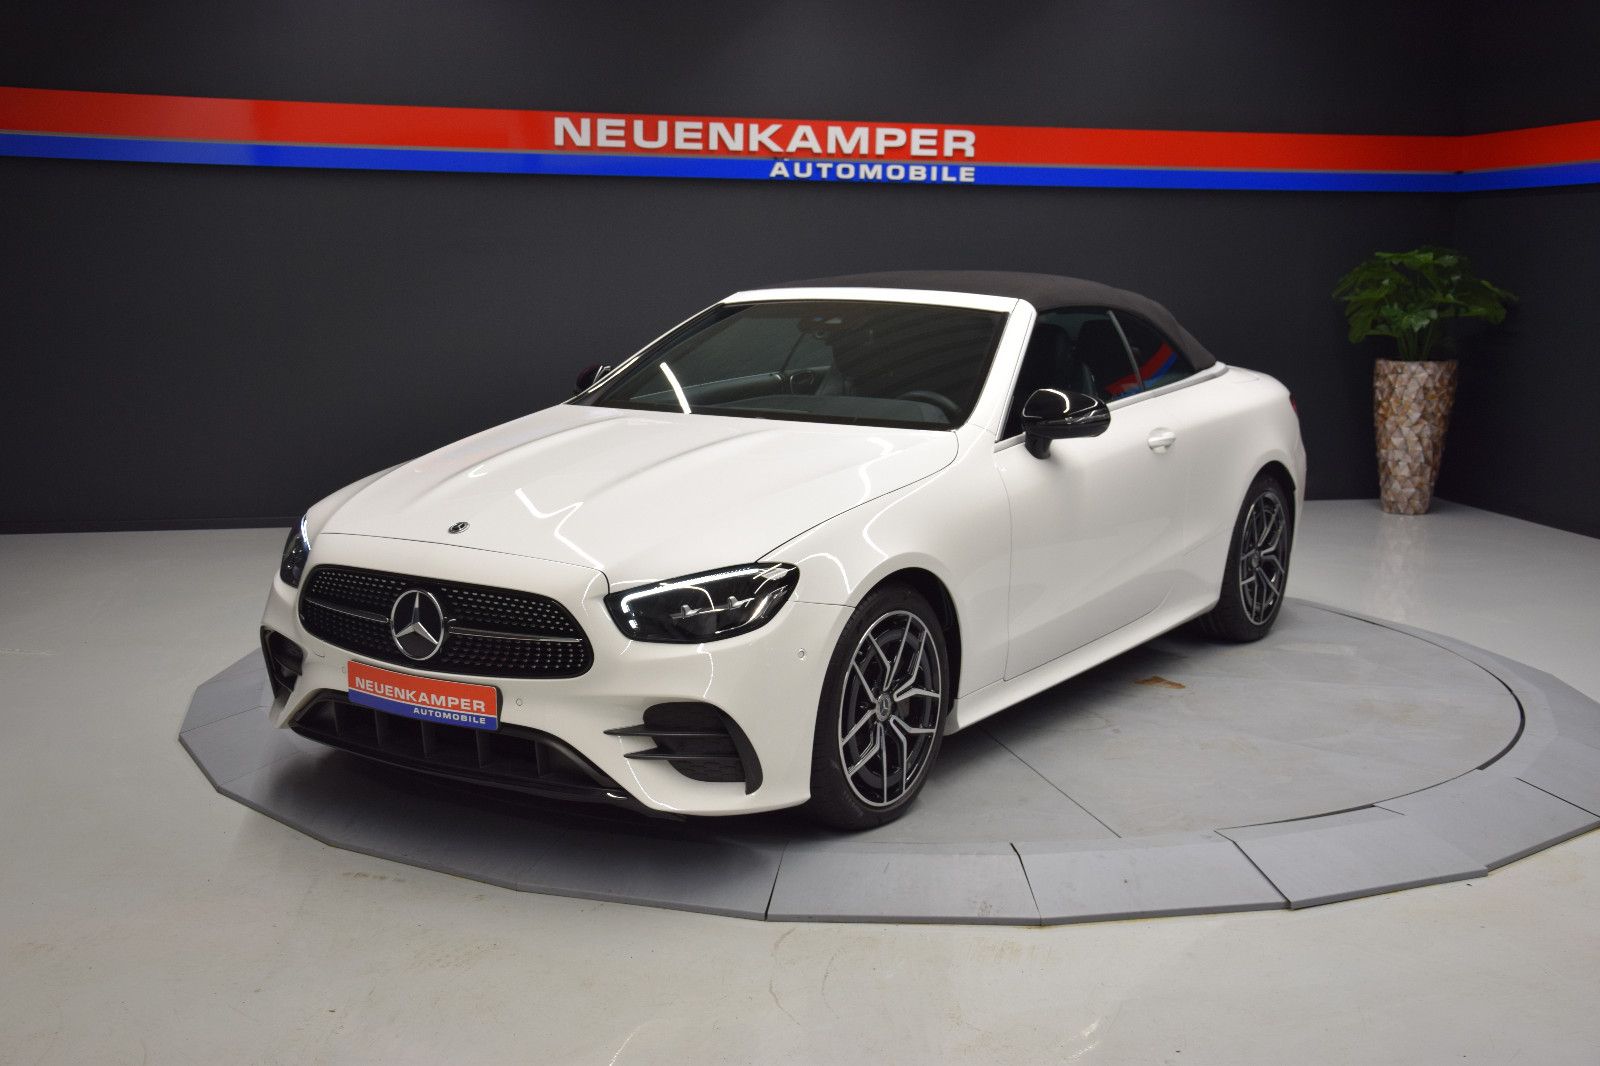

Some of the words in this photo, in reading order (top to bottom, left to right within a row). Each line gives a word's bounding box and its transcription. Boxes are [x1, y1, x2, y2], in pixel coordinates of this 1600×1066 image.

[554, 116, 976, 157] NEUENKAMPER
[769, 160, 976, 182] AUTOMOBILE
[355, 676, 486, 712] NEUENKAMPER
[413, 707, 486, 725] AUTOMOBILE
